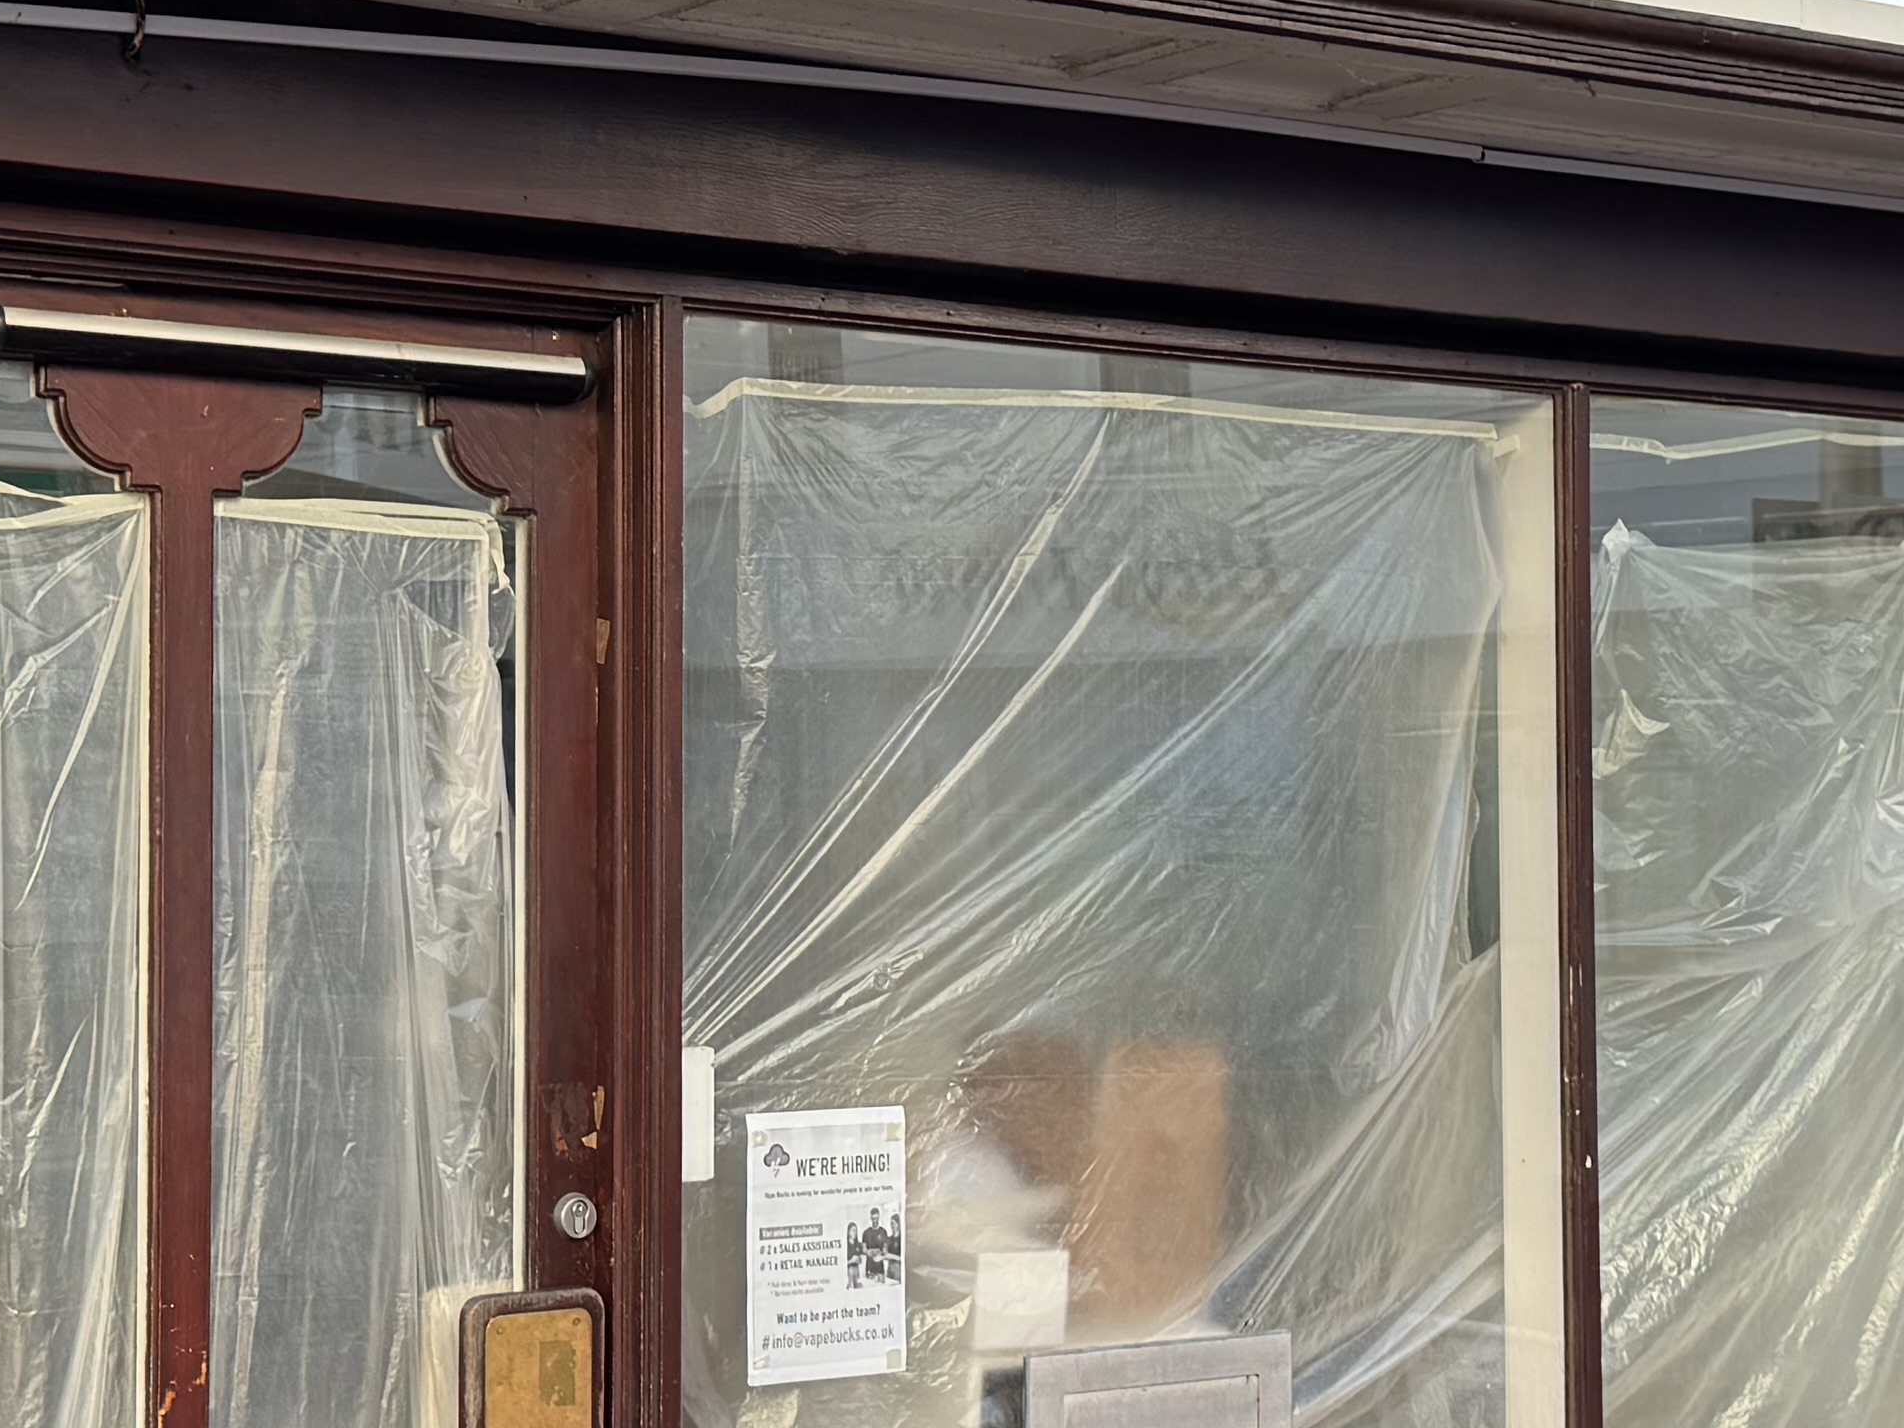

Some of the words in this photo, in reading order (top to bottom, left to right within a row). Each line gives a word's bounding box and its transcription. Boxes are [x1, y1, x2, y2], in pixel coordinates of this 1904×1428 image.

[796, 1156, 838, 1178] WE'RE
[841, 1153, 891, 1175] HIRING!
[779, 1242, 801, 1254] SALES
[776, 1312, 798, 1325] Want
[799, 1312, 808, 1323] to
[809, 1309, 820, 1323] be
[821, 1308, 839, 1323] part
[840, 1306, 854, 1319] the
[856, 1303, 881, 1318] team?
